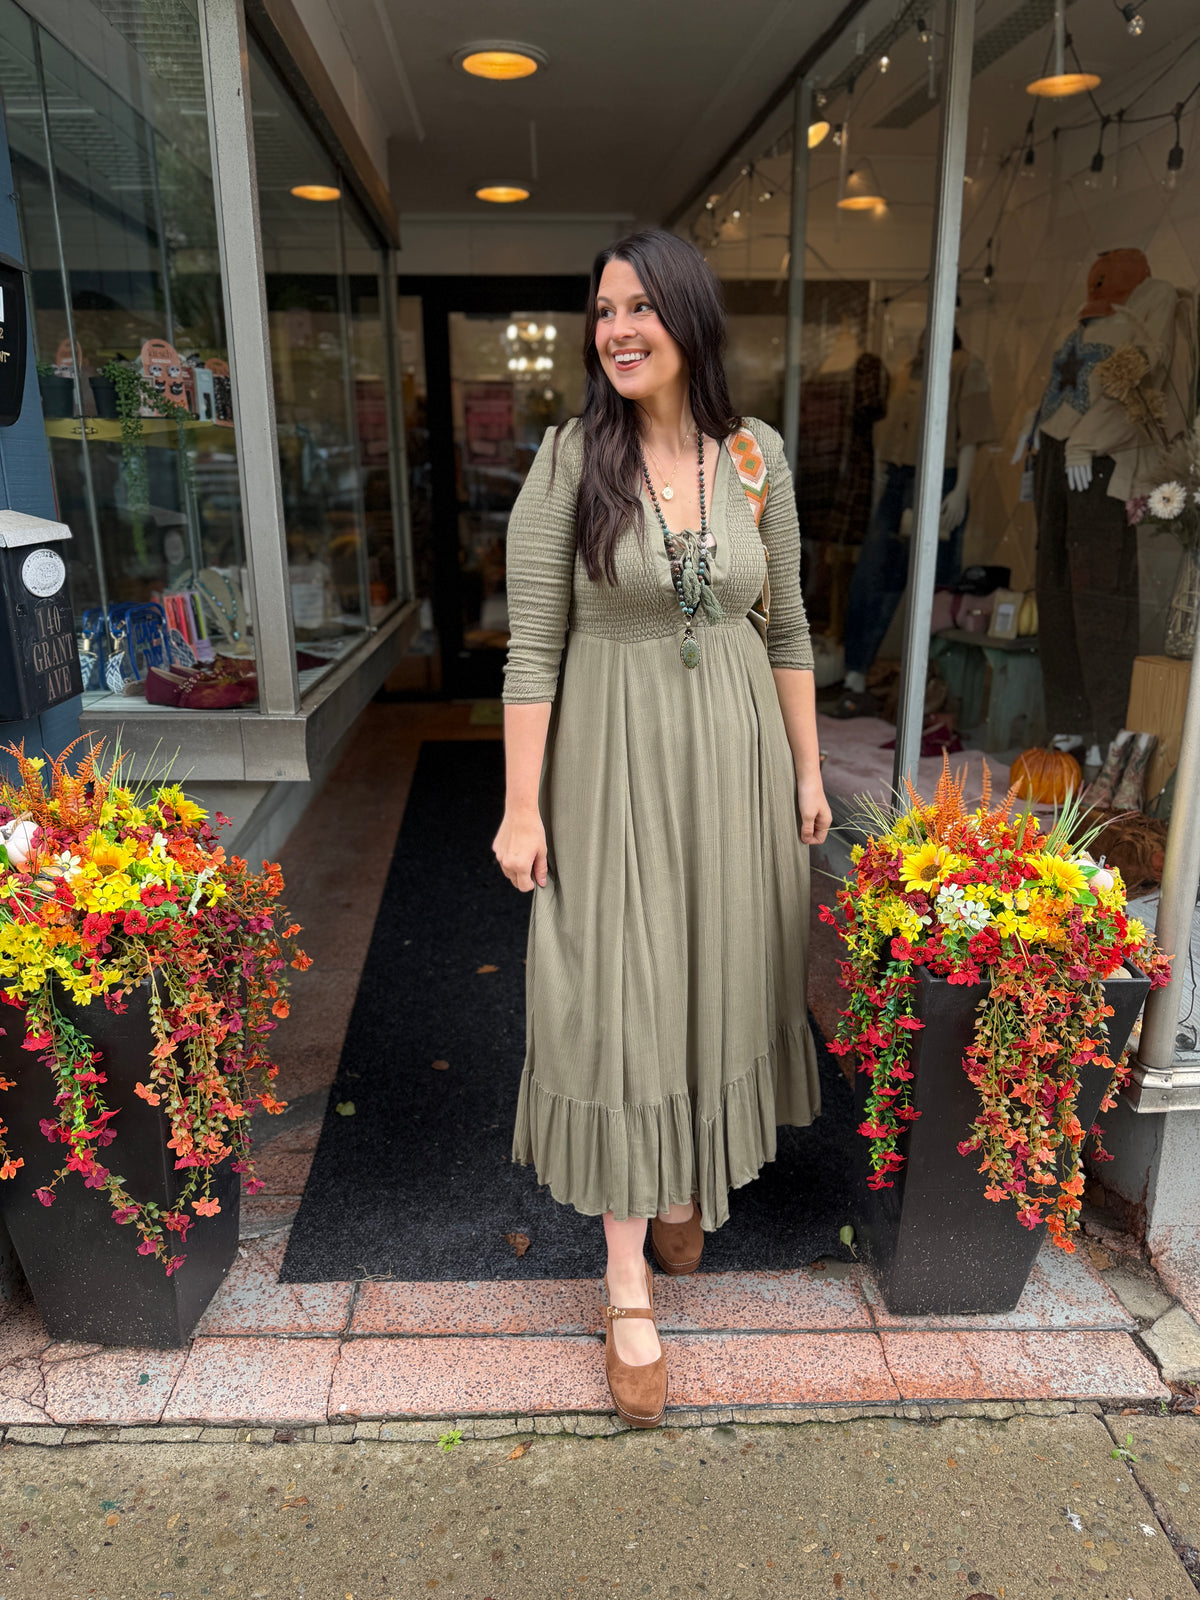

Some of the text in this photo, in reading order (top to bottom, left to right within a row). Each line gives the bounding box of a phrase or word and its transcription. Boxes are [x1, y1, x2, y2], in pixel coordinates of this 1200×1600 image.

[37, 605, 62, 638] 140
[33, 632, 74, 673] GRANT
[48, 665, 72, 700] AVE
